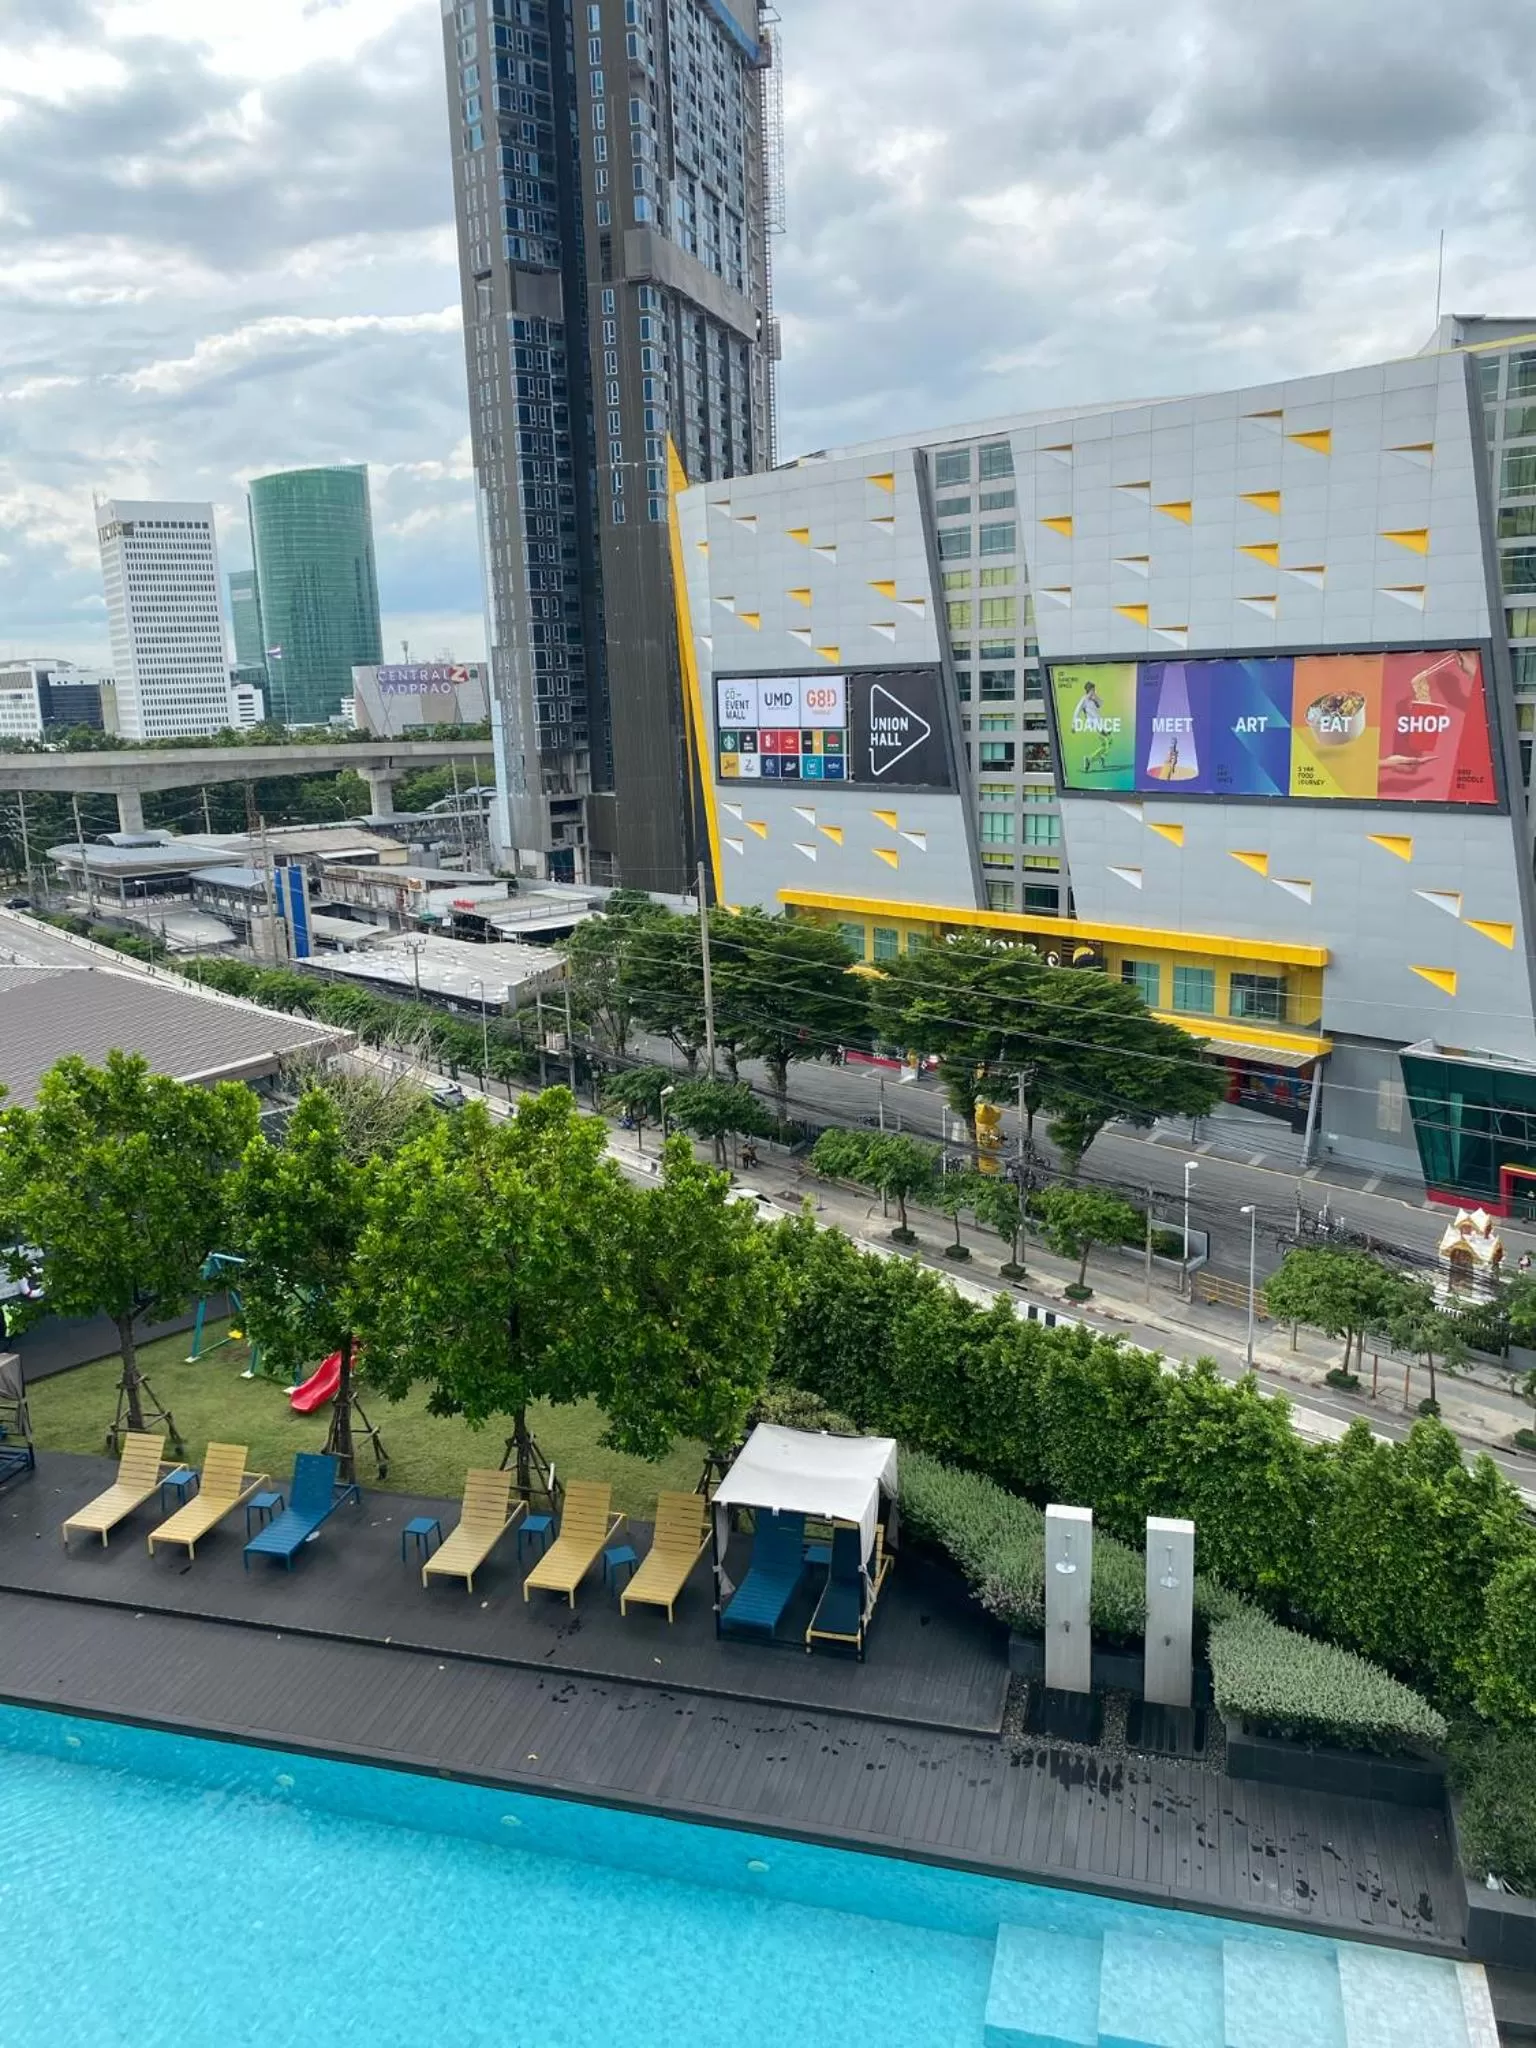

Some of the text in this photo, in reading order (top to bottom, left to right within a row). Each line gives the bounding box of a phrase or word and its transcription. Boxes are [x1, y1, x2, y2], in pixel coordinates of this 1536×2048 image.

[378, 668, 449, 682] CENTRAL
[379, 682, 452, 695] LADPRAO
[725, 699, 751, 710] EVENT
[764, 692, 793, 706] UMD
[725, 709, 747, 720] MALL
[870, 716, 909, 731] UNION
[1074, 717, 1121, 732] DANCE
[1152, 717, 1194, 733] MEET
[1235, 716, 1269, 733] ART
[1319, 716, 1353, 733] EAT
[1397, 716, 1451, 733] SHOP
[870, 732, 902, 746] HALL
